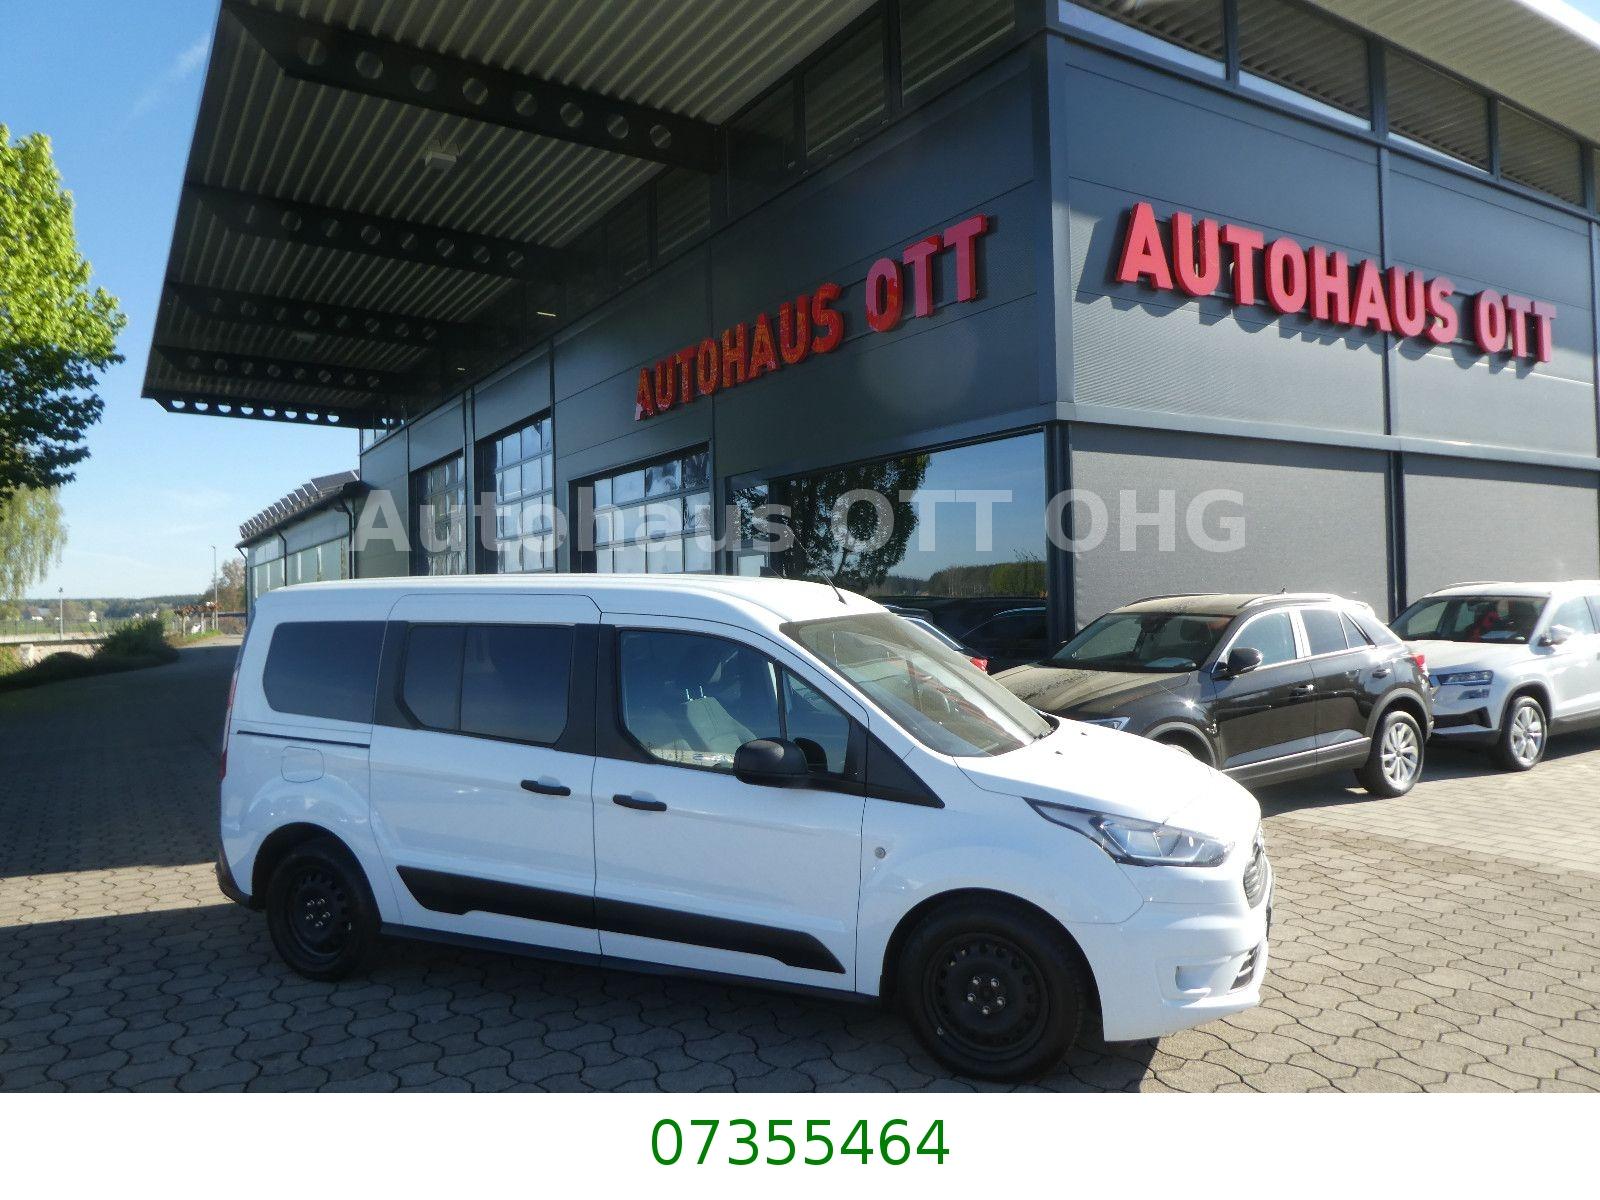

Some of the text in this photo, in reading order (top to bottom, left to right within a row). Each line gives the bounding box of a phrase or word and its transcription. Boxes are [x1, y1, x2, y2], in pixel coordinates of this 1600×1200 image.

[634, 213, 990, 421] AUTOHAUS OTT
[1115, 201, 1557, 363] AUTOHAUS OTT
